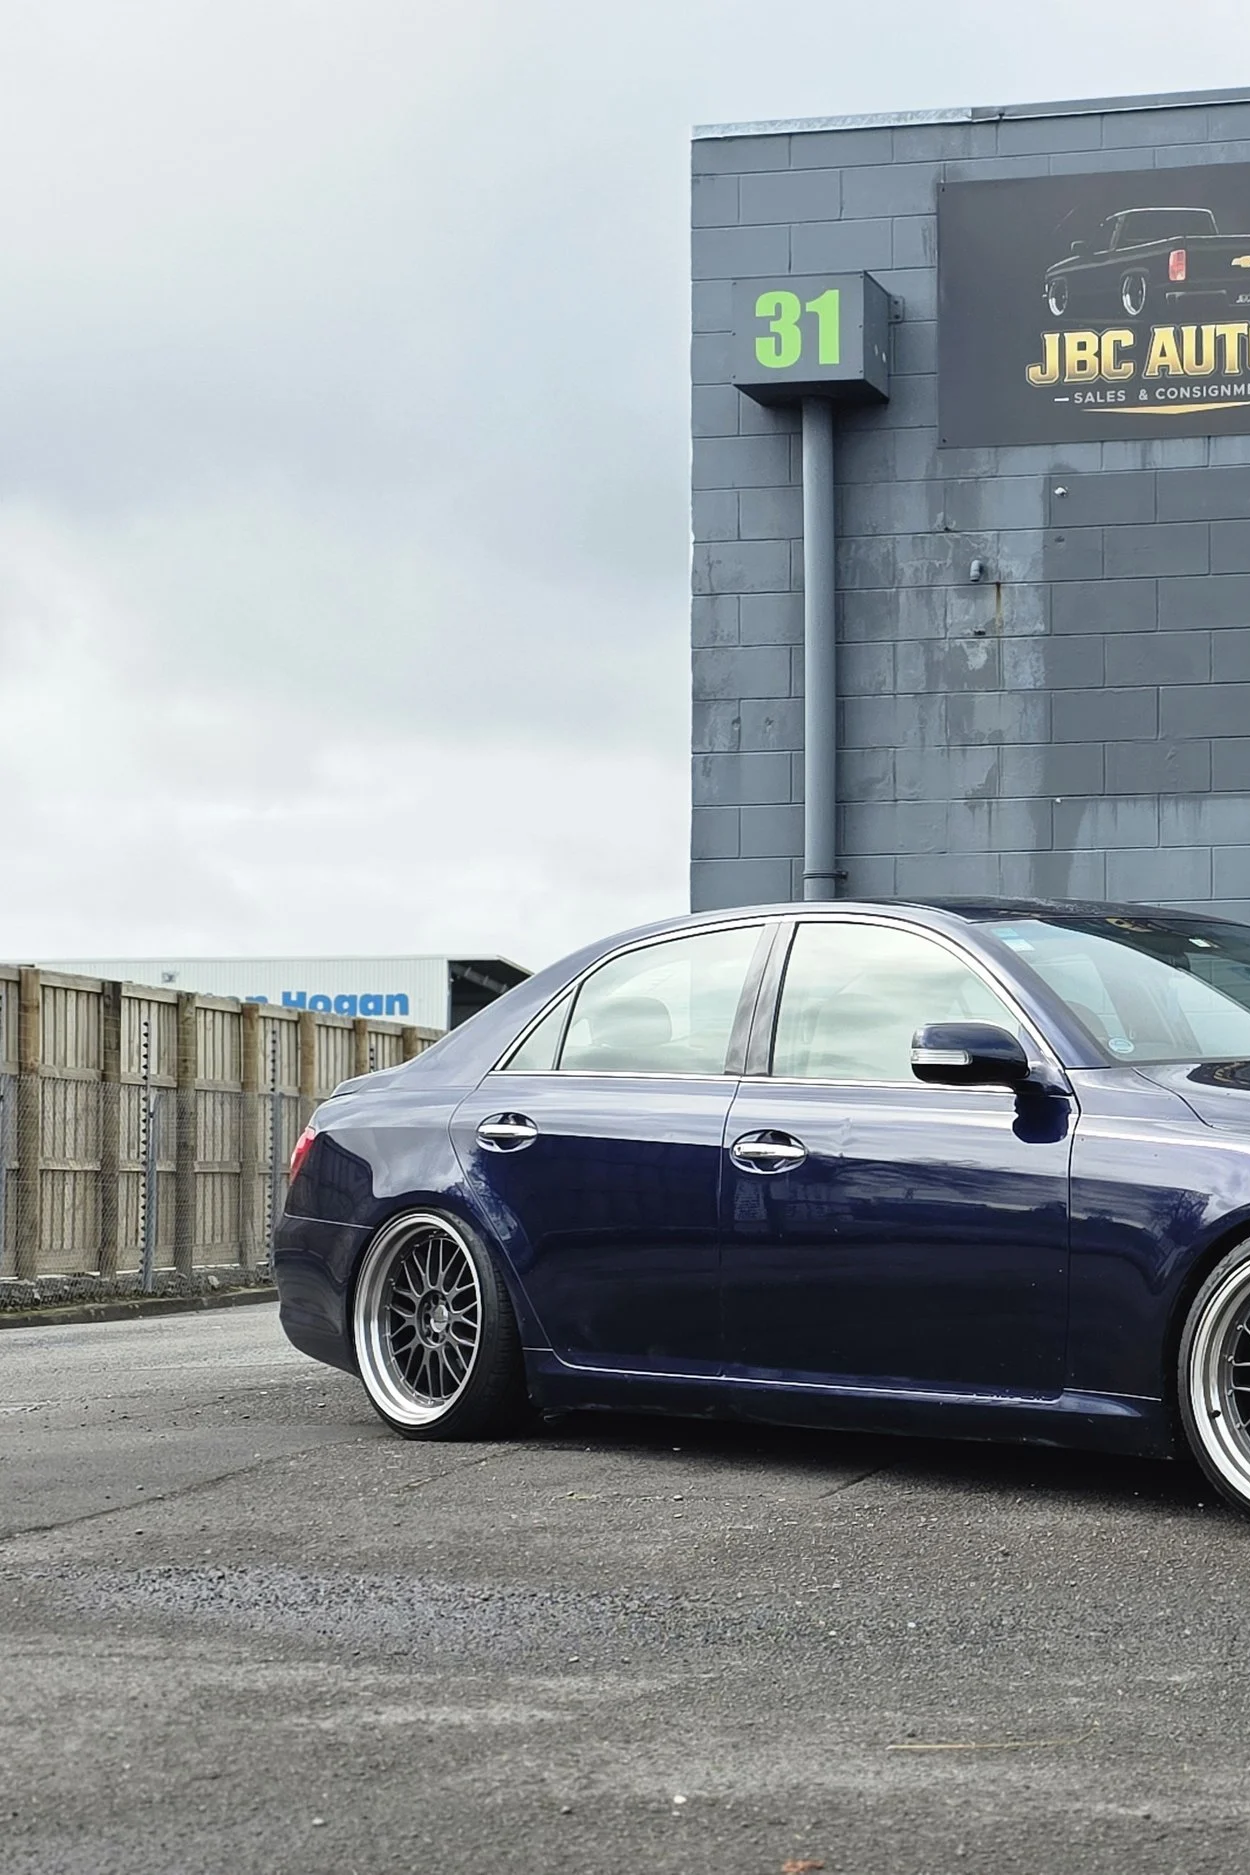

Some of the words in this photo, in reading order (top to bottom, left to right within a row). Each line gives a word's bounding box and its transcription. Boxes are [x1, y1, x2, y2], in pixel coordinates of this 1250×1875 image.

[755, 289, 840, 368] 31
[1026, 328, 1136, 386] JBC
[1074, 389, 1126, 404] SALES
[1138, 388, 1148, 401] &
[282, 991, 410, 1016] Hogan
